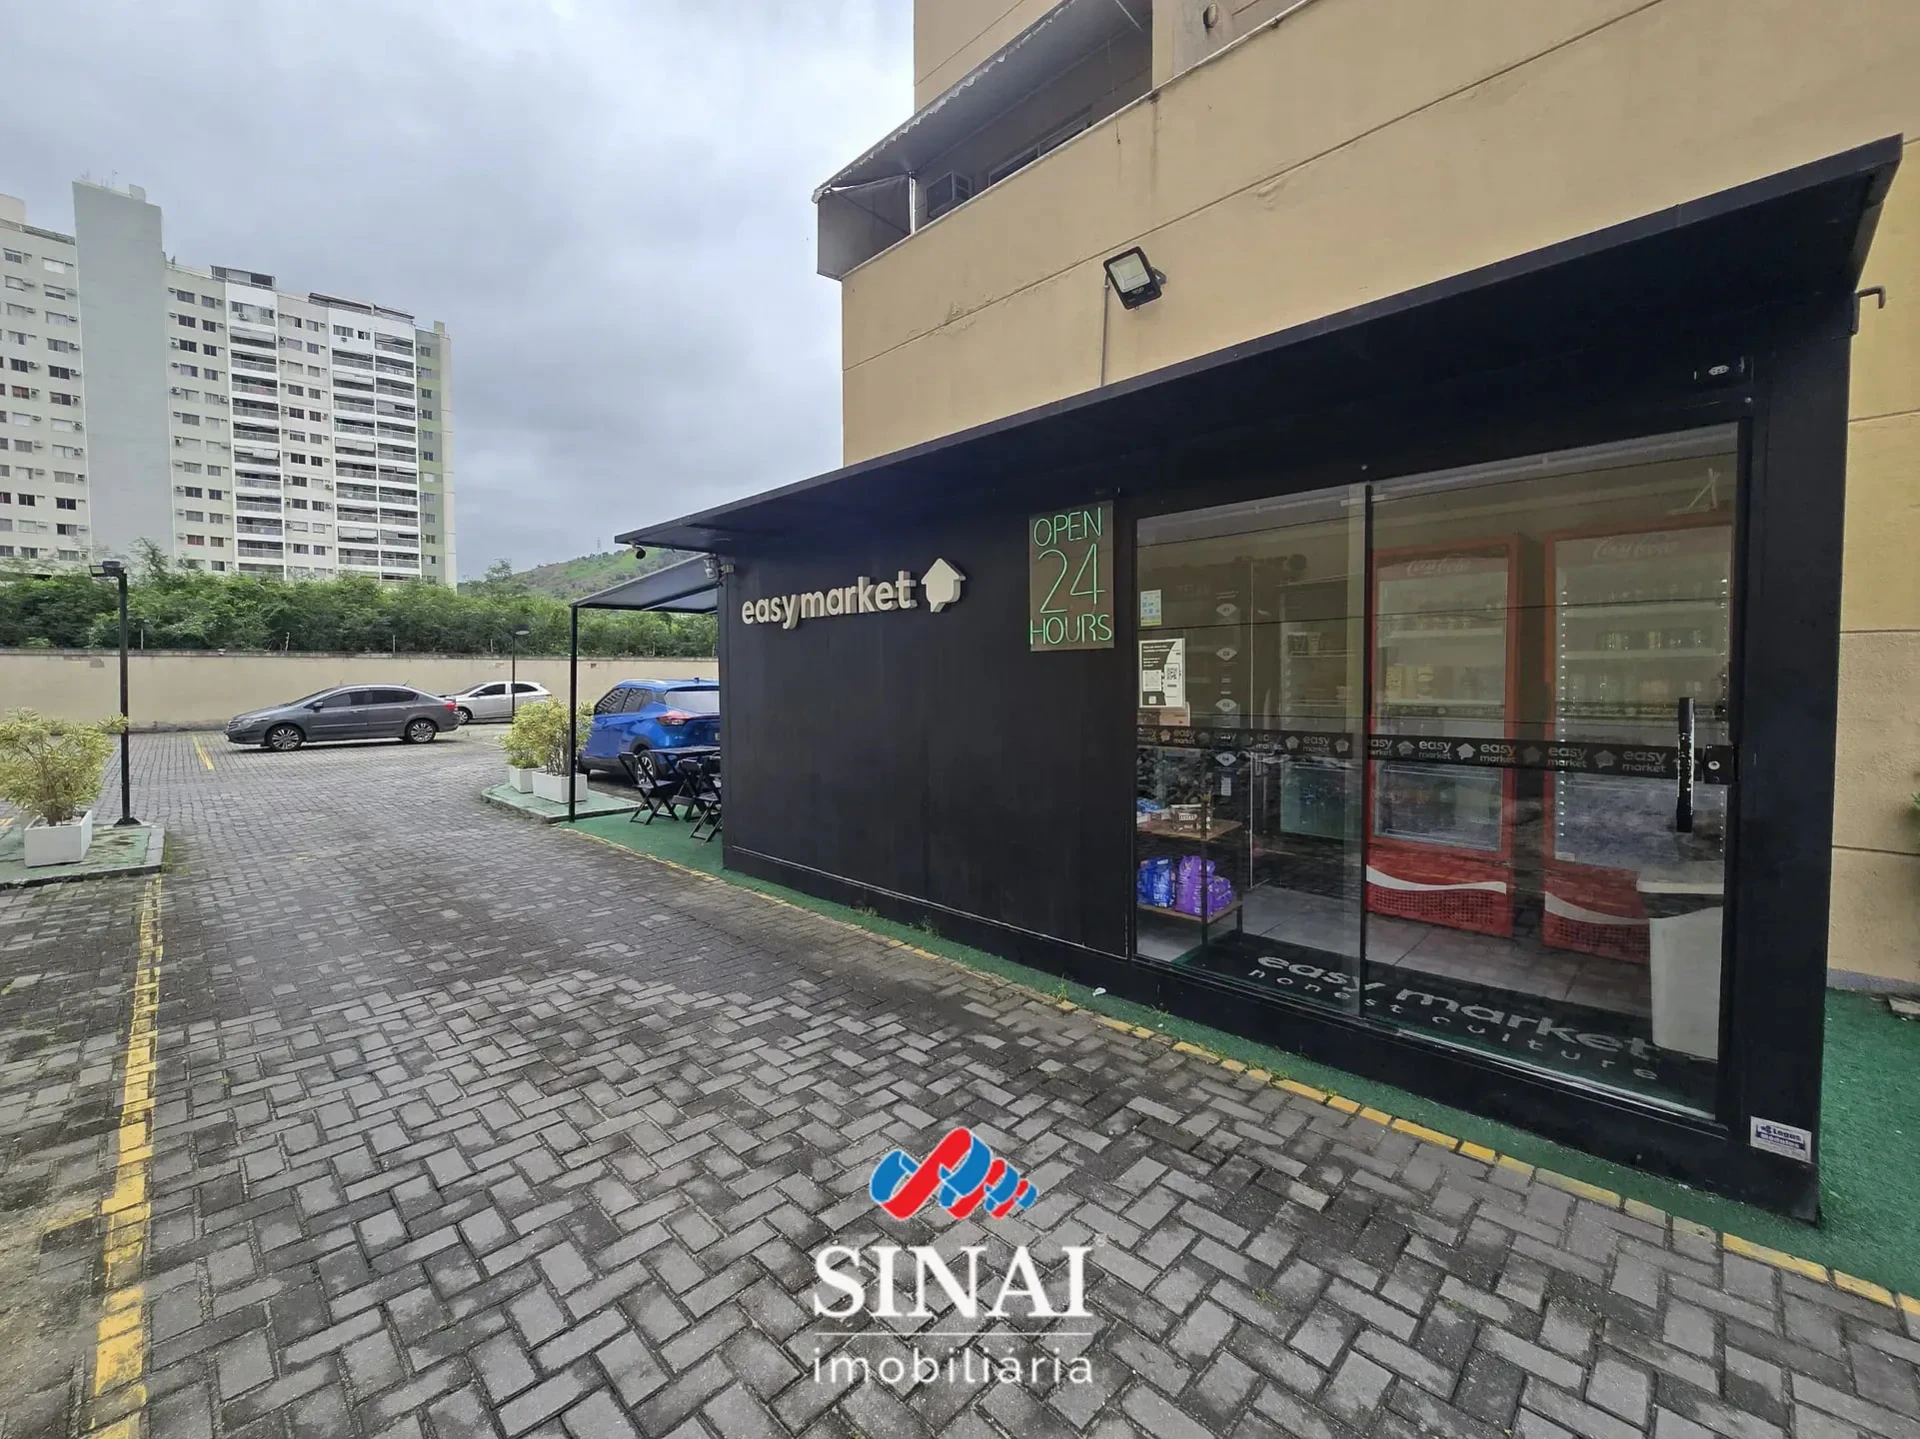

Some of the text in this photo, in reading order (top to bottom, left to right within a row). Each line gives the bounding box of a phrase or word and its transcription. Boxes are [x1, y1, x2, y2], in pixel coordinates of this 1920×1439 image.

[1033, 507, 1102, 547] OPEN
[1037, 543, 1106, 614] 24
[741, 570, 916, 629] easymarket
[1029, 613, 1113, 645] HOURS
[1174, 729, 1196, 739] easy
[1303, 736, 1330, 747] easy
[1419, 740, 1451, 753] easy
[1419, 751, 1451, 760] market
[1480, 743, 1516, 756] easy
[1549, 747, 1588, 760] easy
[1480, 755, 1516, 764] market
[1548, 758, 1588, 768] market
[1623, 750, 1667, 764] easy
[1622, 762, 1666, 773] market
[1257, 956, 1662, 1061] easy market
[1432, 1016, 1658, 1080] culture
